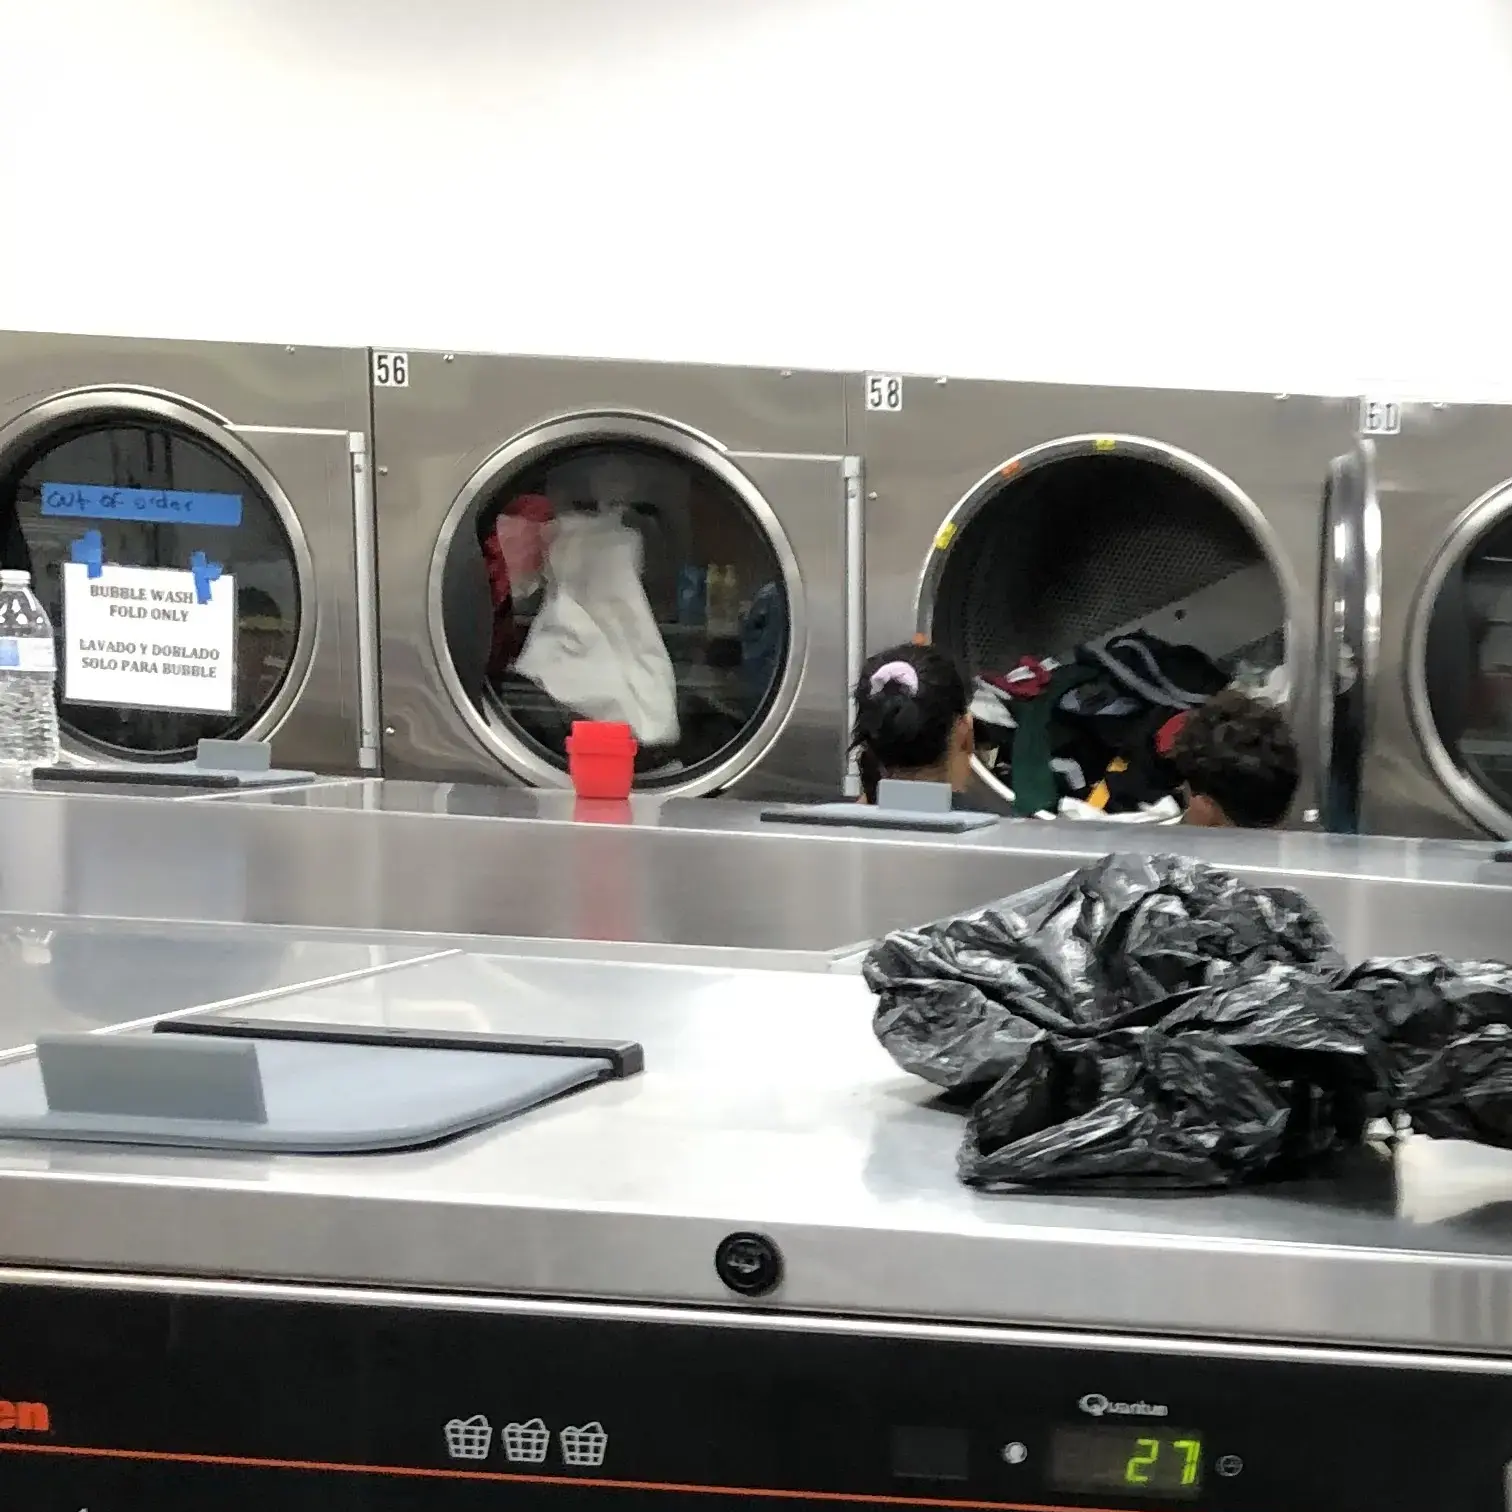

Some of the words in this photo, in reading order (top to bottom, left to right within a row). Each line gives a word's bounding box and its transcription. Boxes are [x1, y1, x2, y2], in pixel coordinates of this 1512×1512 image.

[377, 354, 406, 385] 56
[870, 378, 900, 408] 58
[90, 584, 146, 602] BUBBLE
[150, 588, 194, 604] WASH
[109, 604, 148, 619] FOLD
[150, 607, 189, 622] ONLY
[79, 638, 136, 654] LAVADO
[139, 642, 149, 655] Y
[152, 643, 220, 660] DOBLADO
[81, 656, 118, 671] SOLO
[121, 659, 158, 673] PARA
[162, 663, 217, 678] BUBBLE
[1079, 1393, 1169, 1417] Quantum
[1125, 1438, 1200, 1486] 27
